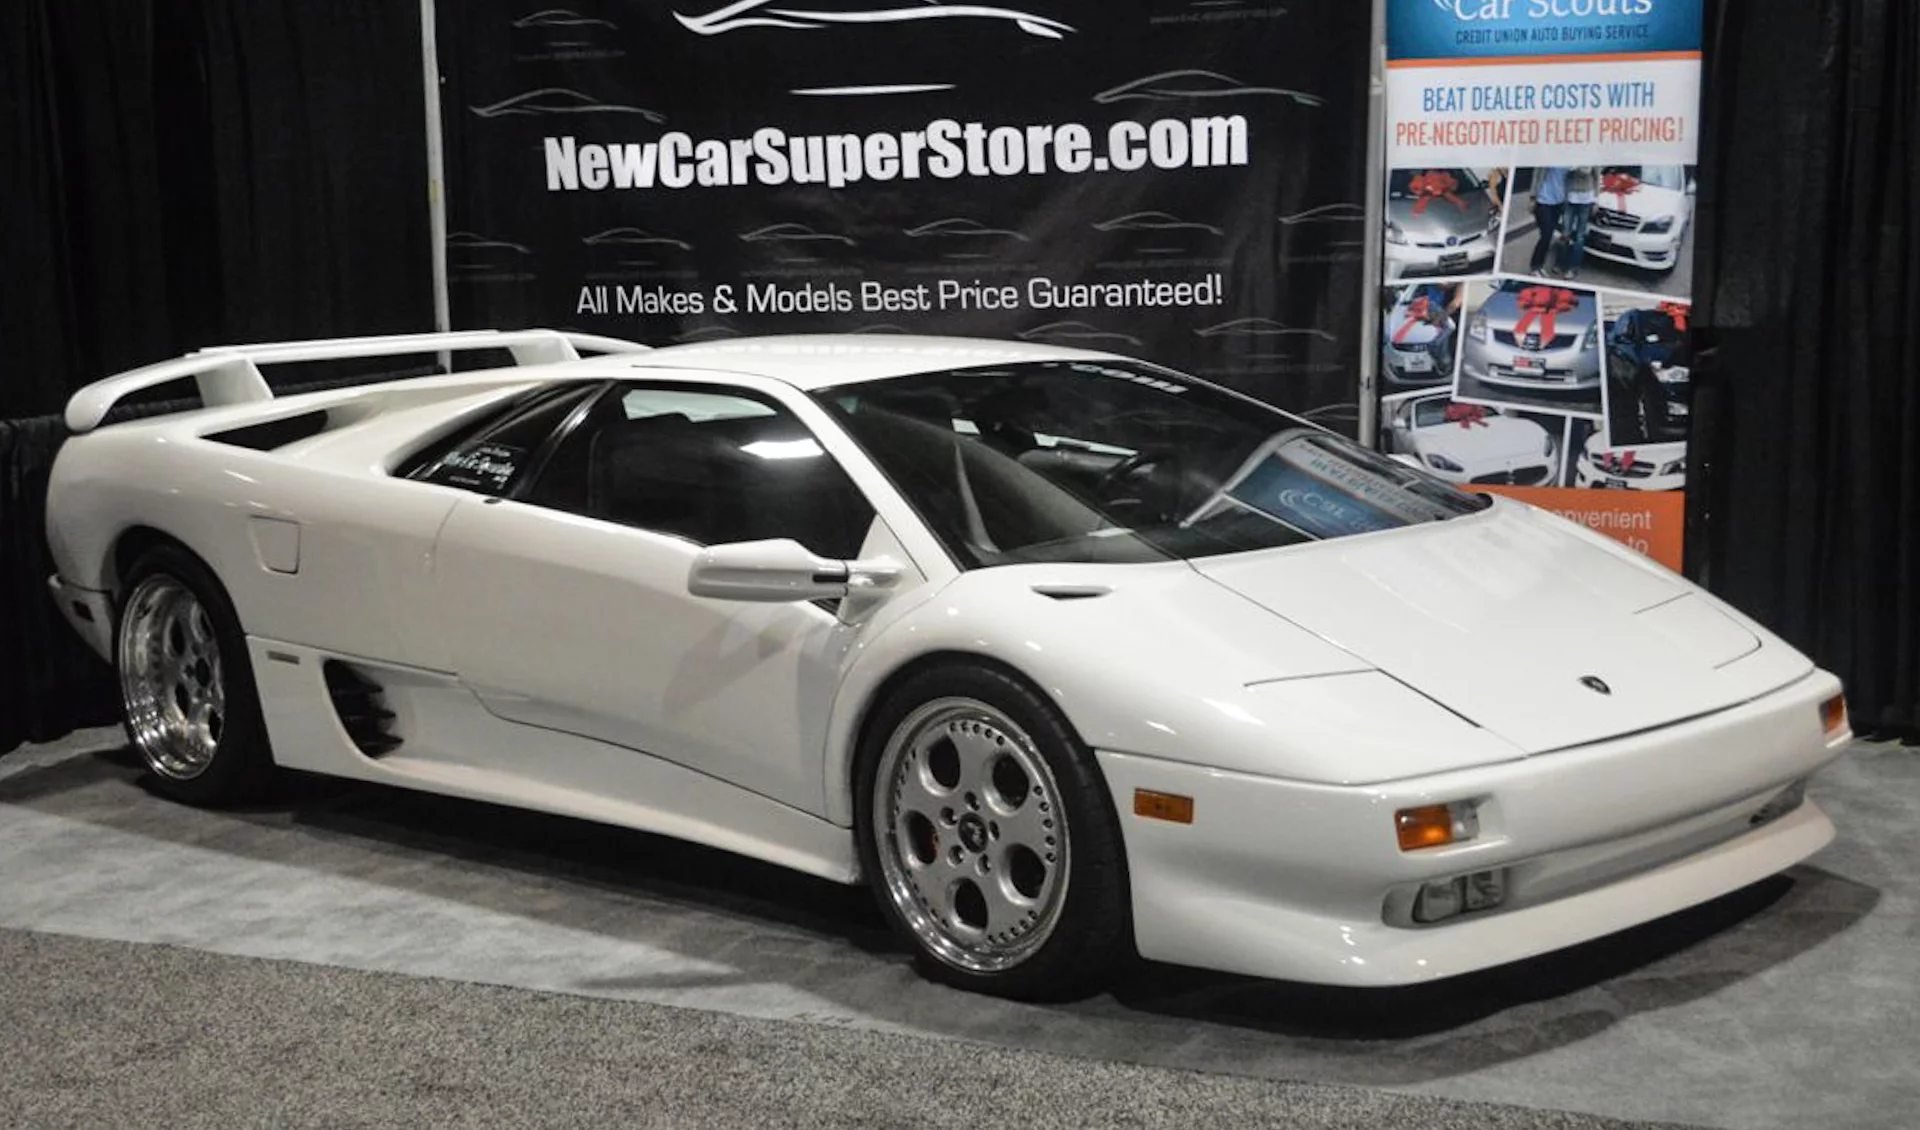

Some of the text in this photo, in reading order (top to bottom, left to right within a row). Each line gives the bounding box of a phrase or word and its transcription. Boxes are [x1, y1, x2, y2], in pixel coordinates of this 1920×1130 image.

[1455, 24, 1649, 45] CREDIT UNION AUTO BUYING SERVICE
[1423, 81, 1655, 112] BEAT DEALER COSTS WITH
[1396, 116, 1684, 146] PRE-NEGOTIATED FLEET PRICING!
[543, 114, 1249, 192] NewCarSuperStore.com
[576, 273, 1223, 314] All Makes & Models Best Price Guaranteed!
[1553, 508, 1653, 530] nvenient
